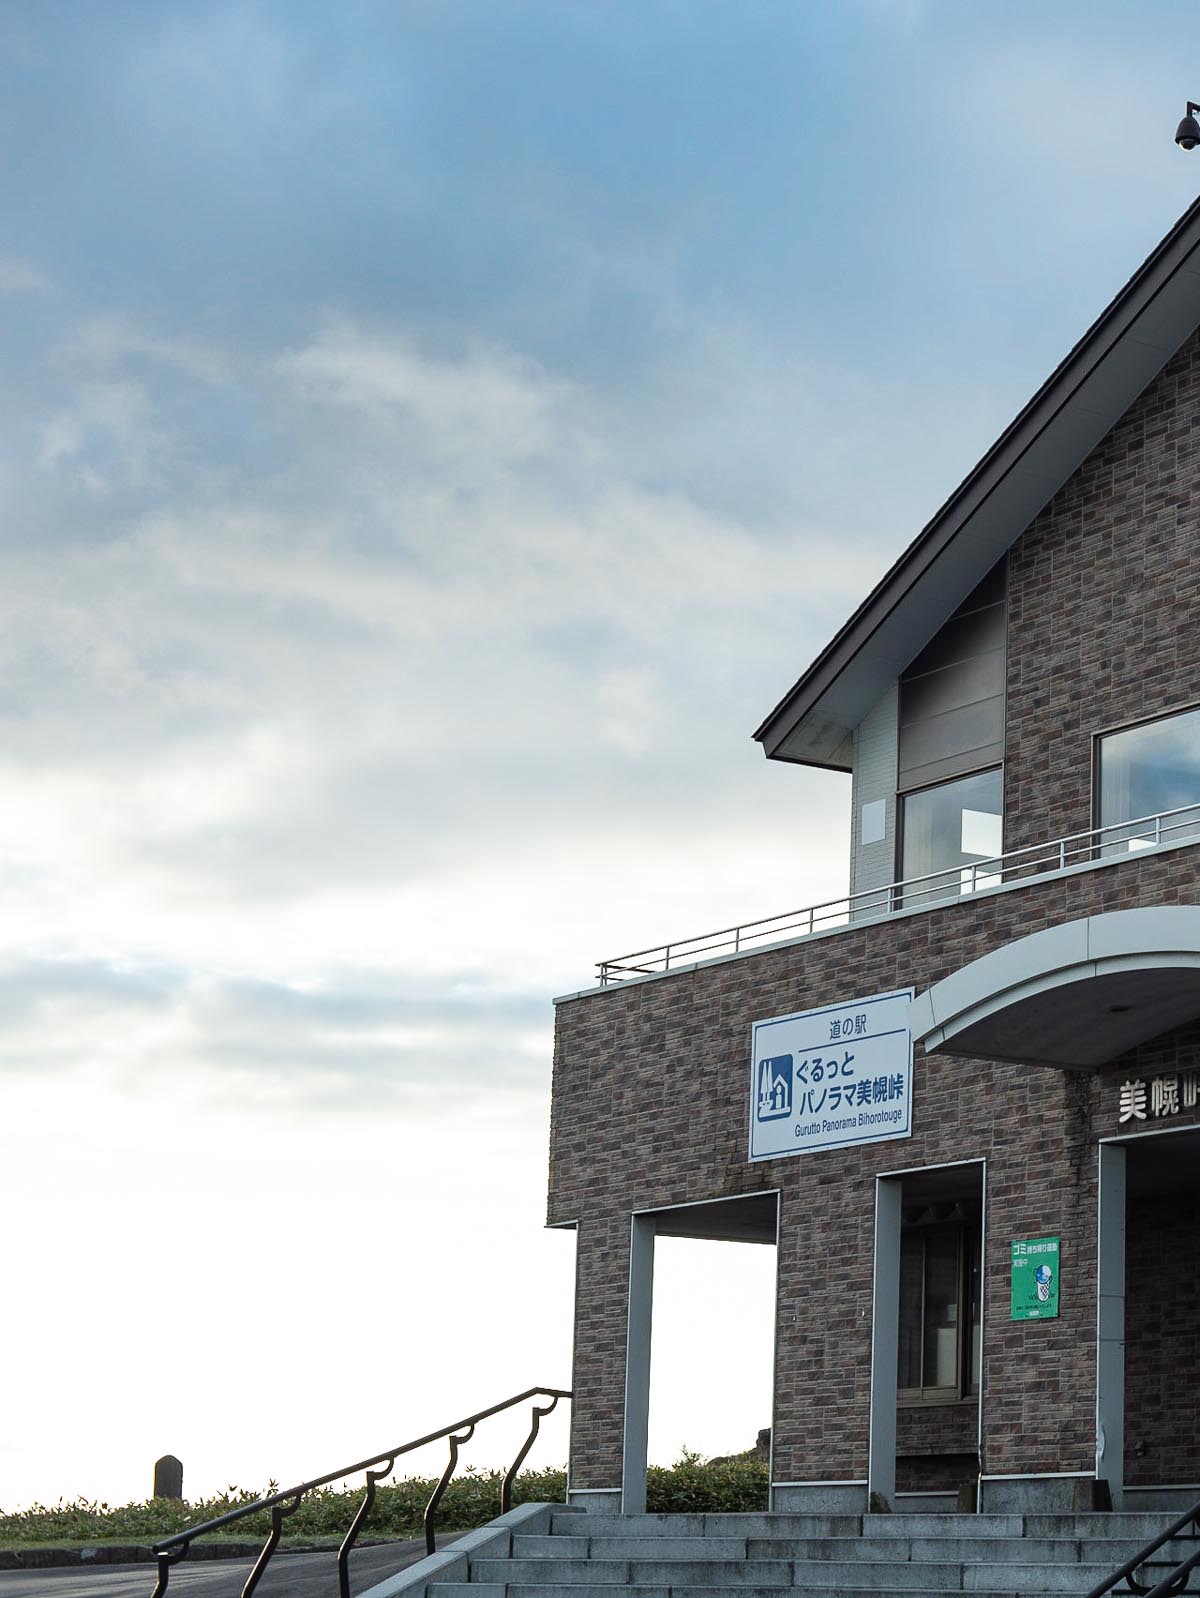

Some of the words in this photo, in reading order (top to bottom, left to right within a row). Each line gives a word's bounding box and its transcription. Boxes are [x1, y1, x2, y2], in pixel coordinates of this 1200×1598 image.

[829, 1014, 867, 1040] 道の駅
[796, 1051, 855, 1085] ぐるっと
[799, 1073, 904, 1116] パノラマ美幌峠
[795, 1121, 821, 1137] Gurutto
[822, 1117, 857, 1133] Panorama
[858, 1109, 902, 1126] Bihorotouge
